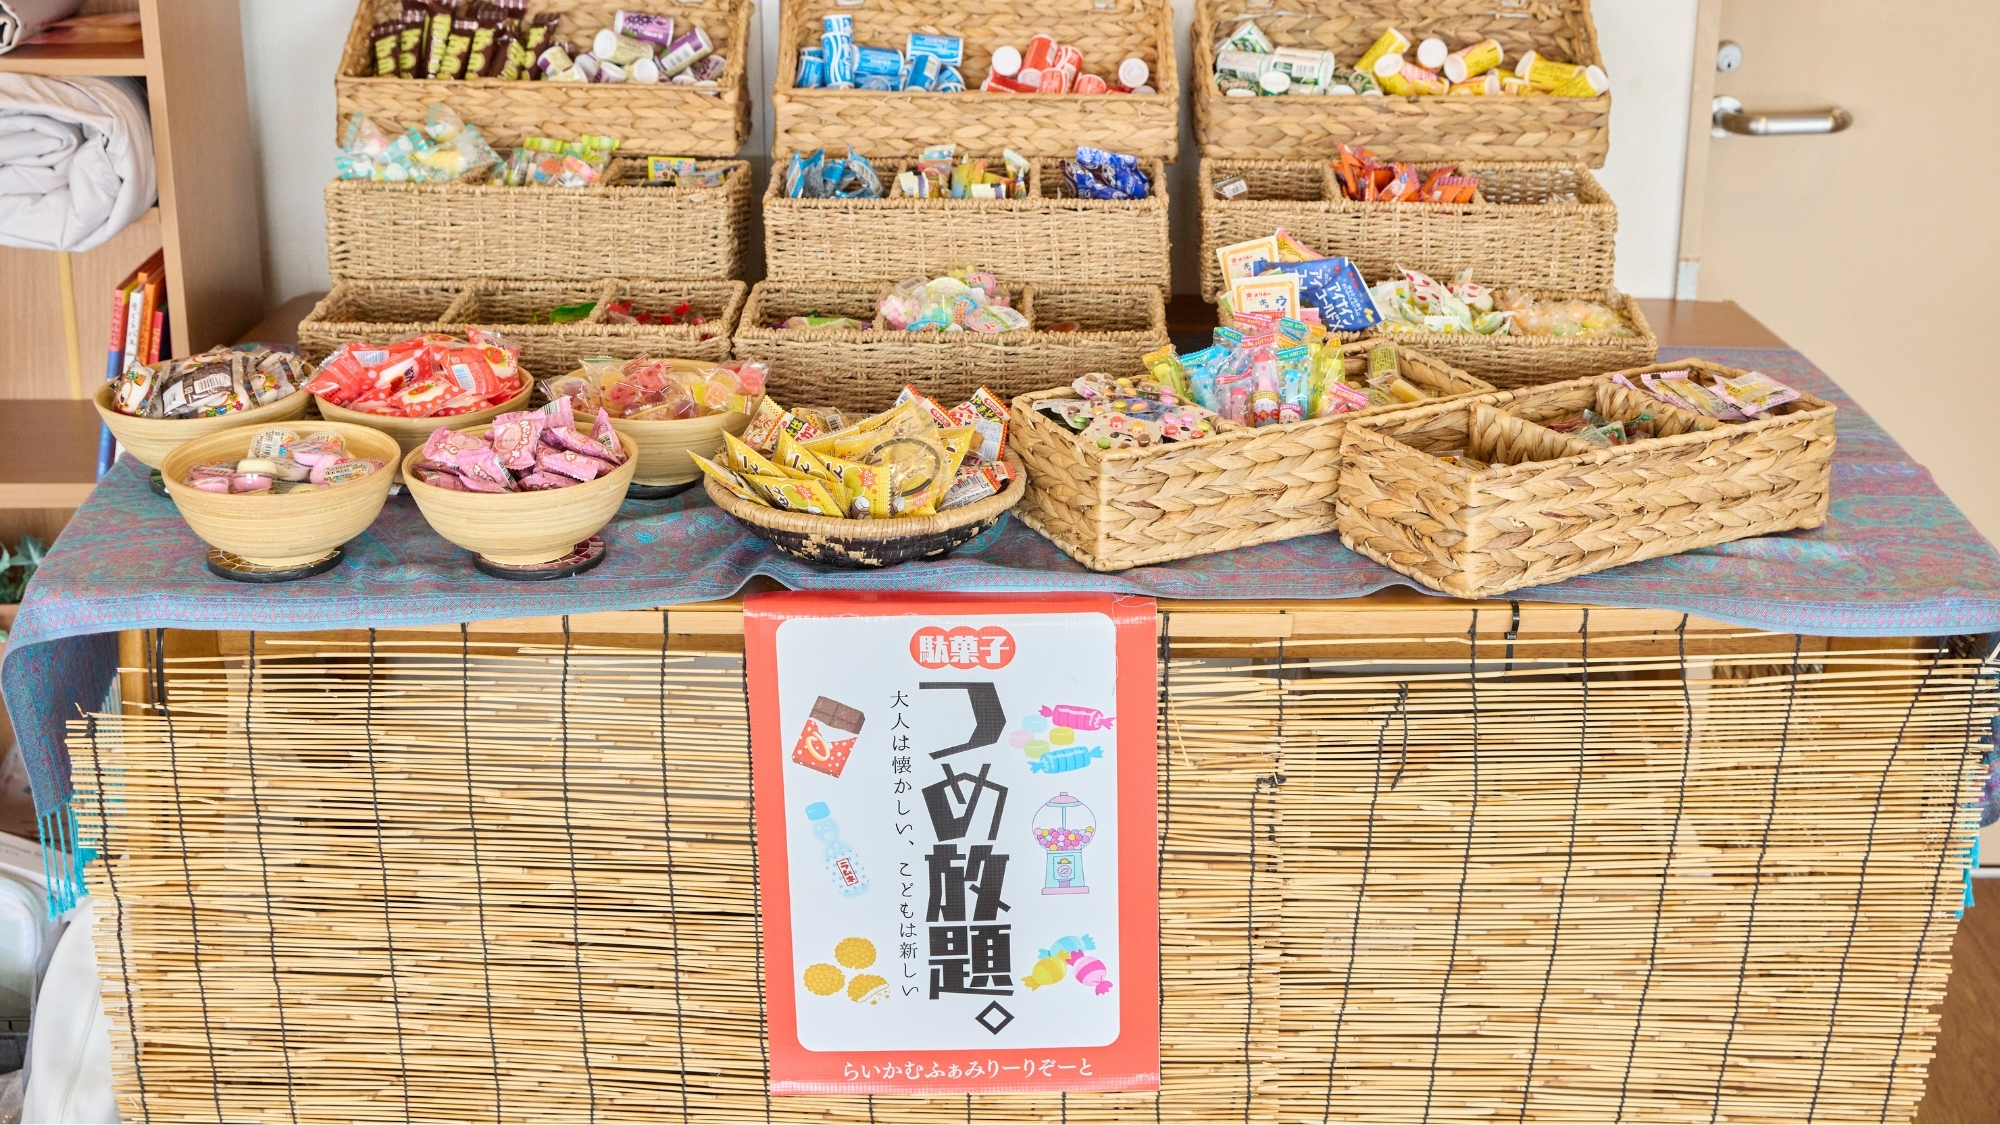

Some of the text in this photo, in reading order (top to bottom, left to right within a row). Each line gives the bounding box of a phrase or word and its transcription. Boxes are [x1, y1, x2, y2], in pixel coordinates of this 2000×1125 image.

[1327, 281, 1355, 325] アイナイン
[1254, 336, 1274, 346] BOTTLE
[918, 634, 1010, 665] 駄菓子
[840, 860, 856, 883] ラムネ
[918, 681, 1015, 1036] つめ放題。
[842, 1057, 1094, 1082] らいかむふぁみりーりぞーと
